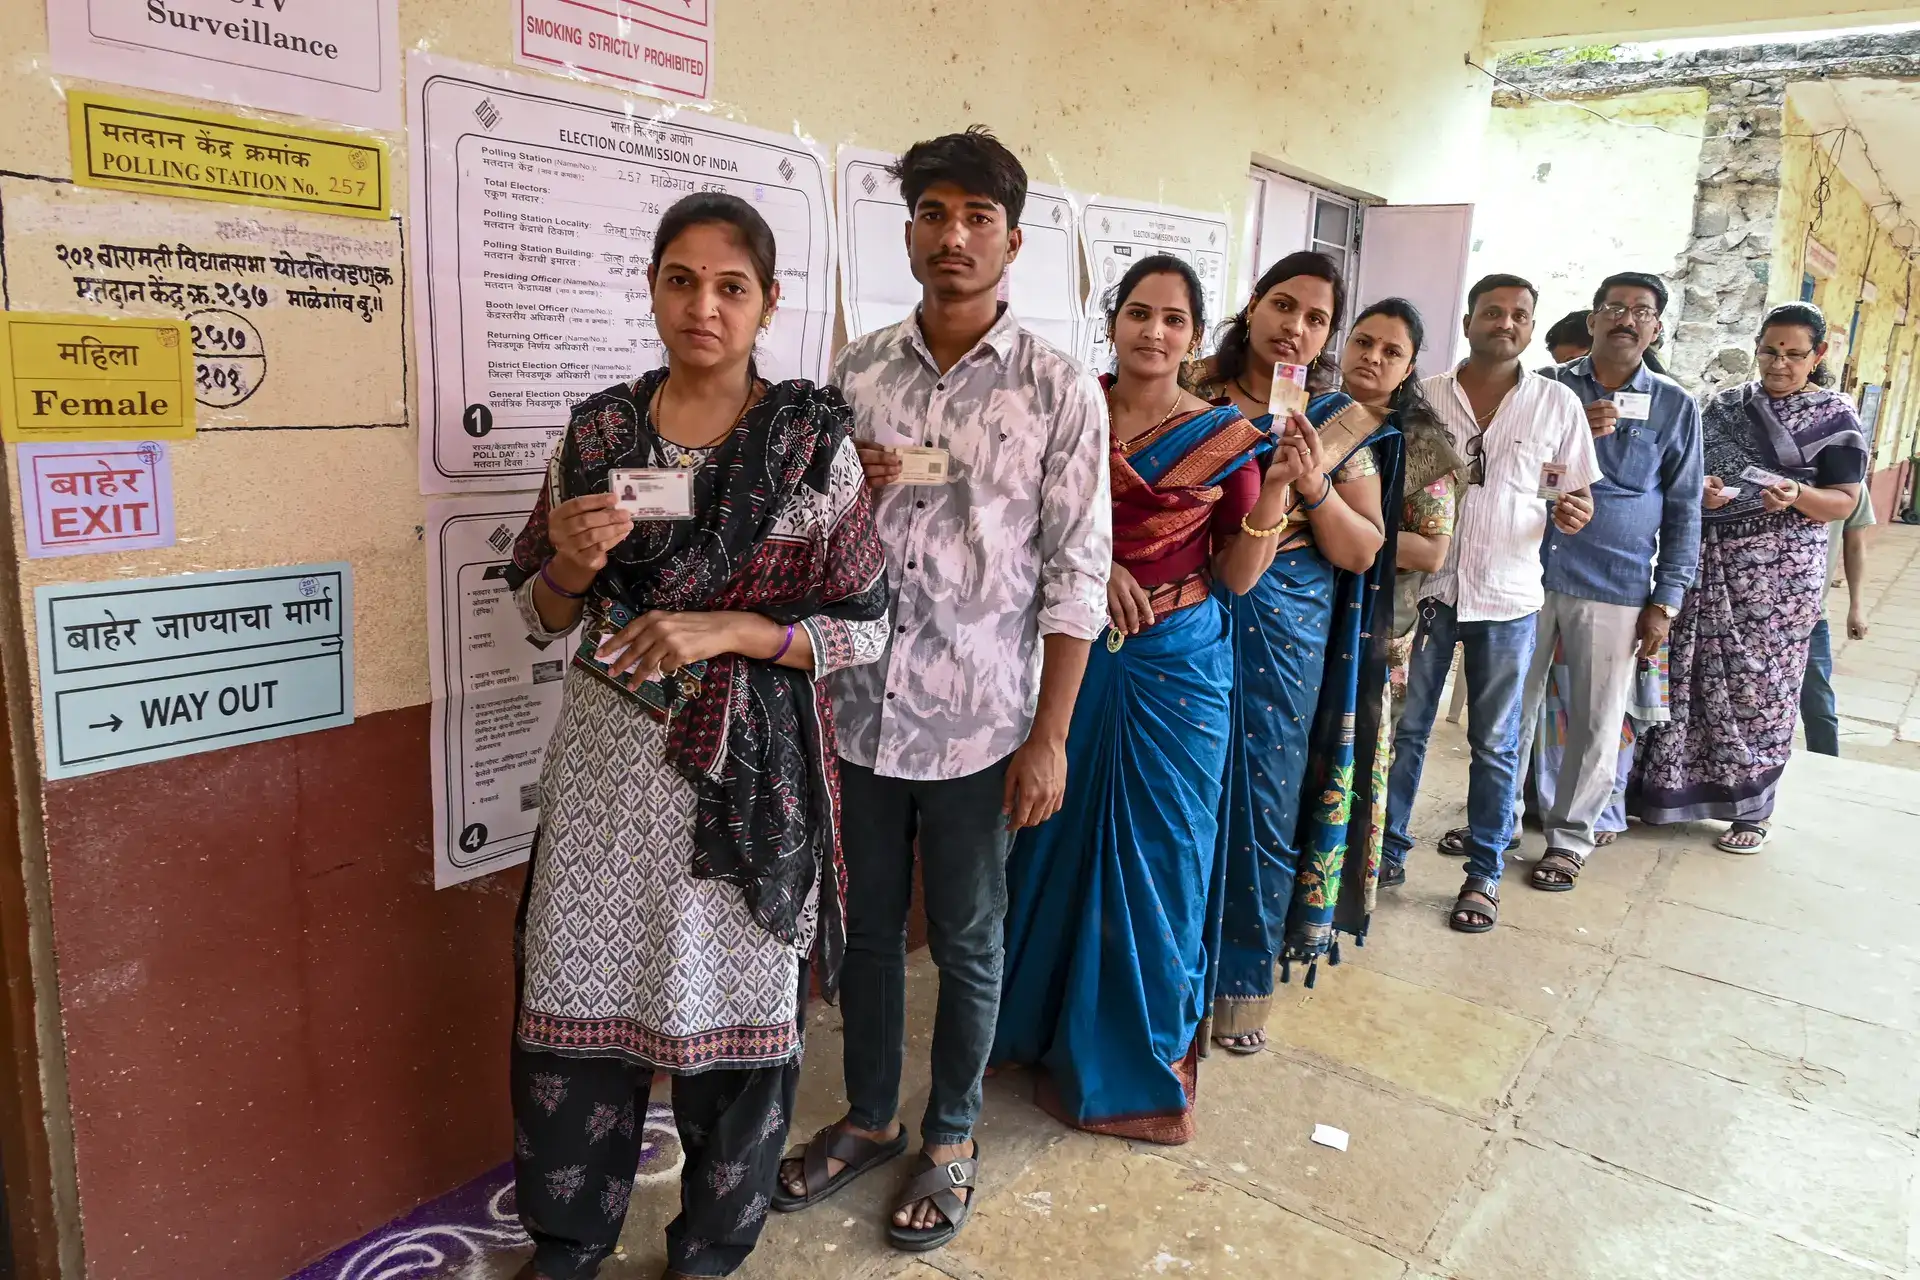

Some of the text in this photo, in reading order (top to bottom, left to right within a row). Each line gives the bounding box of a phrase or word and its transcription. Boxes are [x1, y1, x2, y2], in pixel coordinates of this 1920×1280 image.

[147, 0, 338, 60] Surveillance
[527, 15, 704, 77] SMOKING STRICTLY PROHIBITED
[99, 121, 311, 168] मतदान केंद्र क्रमांक
[669, 132, 694, 147] आयोग
[481, 146, 517, 160] Polling
[519, 152, 553, 164] Station
[559, 129, 739, 173] ELECTION COMMISSION OF INDIA
[482, 158, 514, 170] मतदान
[103, 152, 367, 197] POLLING STATION No. 257
[484, 177, 551, 194] Total Electors:
[484, 189, 508, 201] एकूण
[483, 209, 592, 230] Polling Station Locality:
[483, 219, 515, 231] मतदान
[483, 239, 595, 259] Polling Station Building:
[483, 250, 514, 261] मतदान
[56, 244, 95, 270] २०१
[97, 243, 174, 273] बारामती
[175, 243, 267, 277] विधानसभा
[483, 270, 529, 282] Presiding
[531, 273, 562, 284] Officer
[484, 280, 514, 291] मतदान
[73, 276, 146, 310] मतदान
[148, 274, 187, 311] केंद्र
[485, 300, 514, 310] Booth
[516, 302, 537, 311] level
[538, 304, 569, 313] Officer
[529, 312, 565, 323] अधिकारी
[487, 331, 531, 342] Returning
[533, 333, 563, 342] Officer
[57, 336, 140, 371] महिला
[487, 340, 524, 352] निवडणूक
[527, 340, 551, 351] निर्णय
[554, 341, 589, 352] अधिकारी
[488, 361, 520, 370] District
[522, 361, 558, 370] Election
[560, 362, 590, 370] Officer
[488, 369, 513, 380] जिल्हा
[516, 370, 552, 381] निवडणूक
[555, 370, 591, 380] अधिकारी
[33, 389, 169, 417] Female
[489, 390, 524, 399] General
[526, 391, 561, 399] Election
[526, 399, 562, 409] निवडणूक
[471, 408, 482, 434] 1
[473, 451, 497, 459] POLL
[473, 460, 501, 468] मतदान
[46, 460, 145, 498] बाहेर
[52, 502, 150, 537] EXIT
[63, 586, 334, 652] बाहेर जाण्याचा मार्ग
[140, 680, 279, 730] WAY OUT
[465, 827, 480, 849] 4
